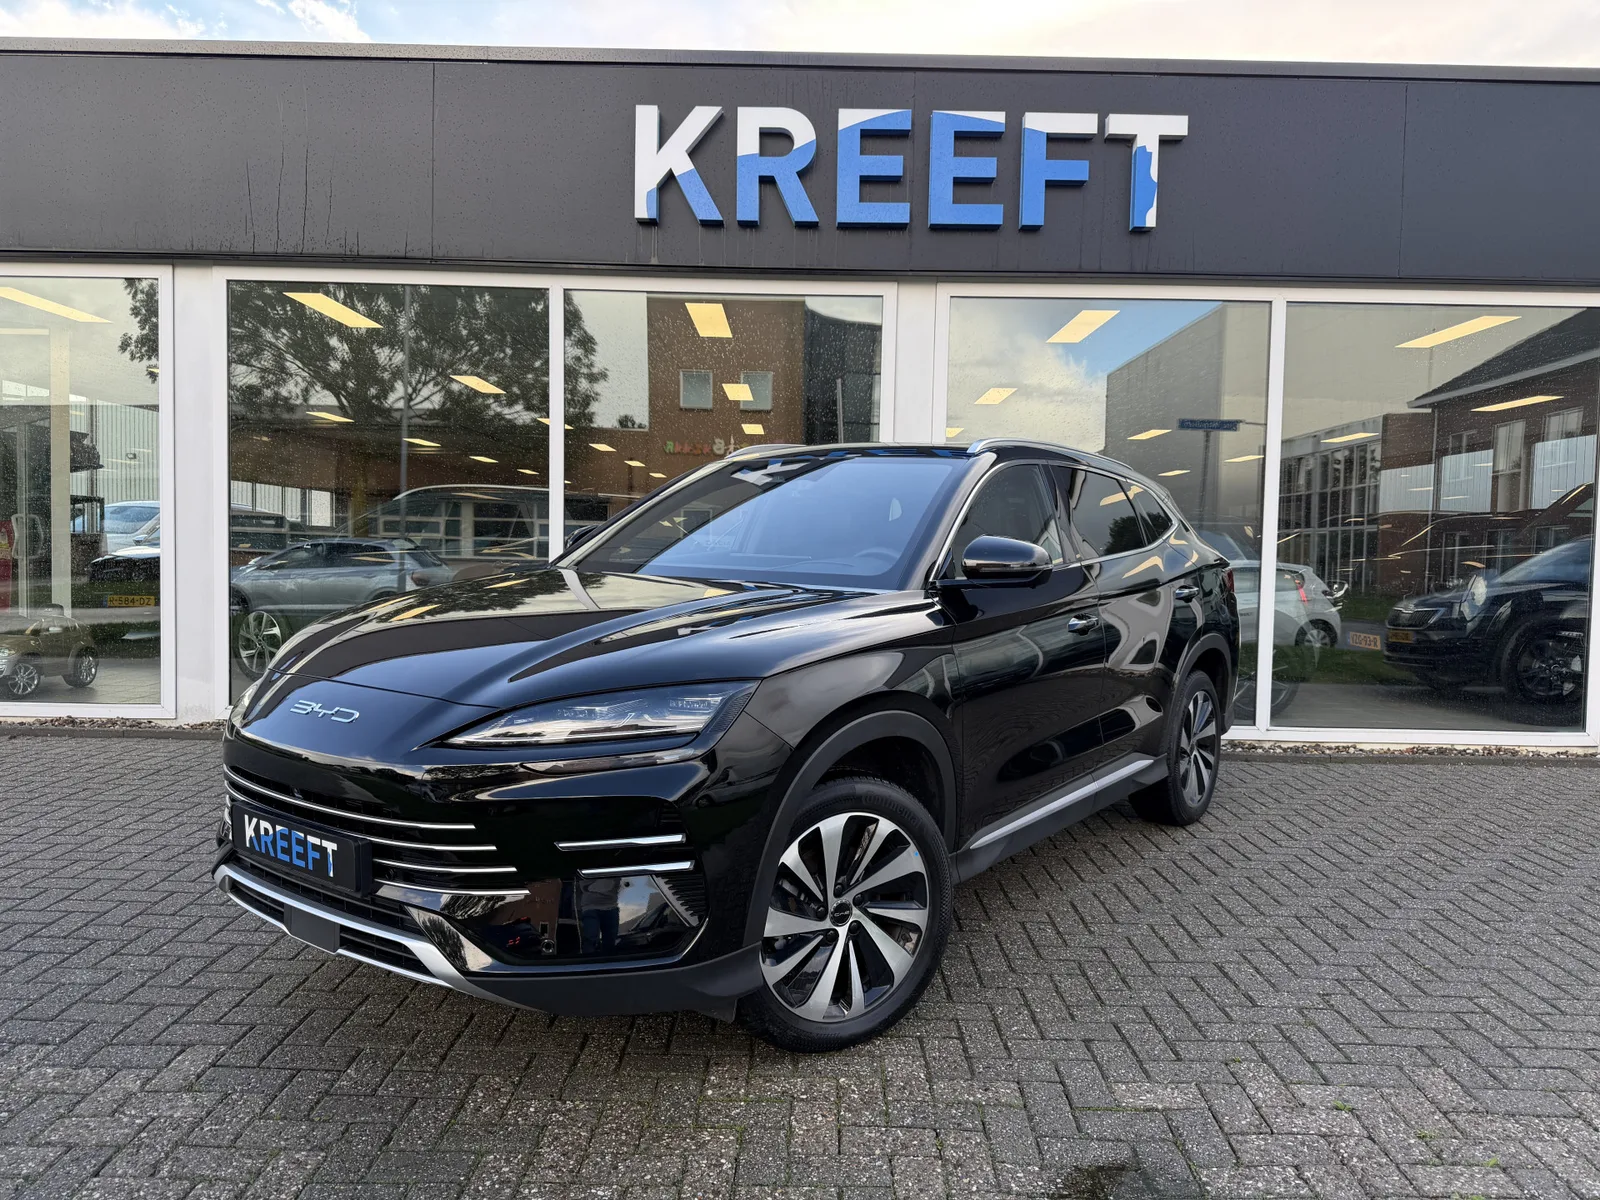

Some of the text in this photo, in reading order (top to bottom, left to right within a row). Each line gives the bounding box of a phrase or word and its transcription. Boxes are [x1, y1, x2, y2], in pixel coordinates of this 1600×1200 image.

[634, 104, 1189, 232] KREEFT
[289, 700, 360, 723] BYD
[244, 814, 338, 878] KREEFT
